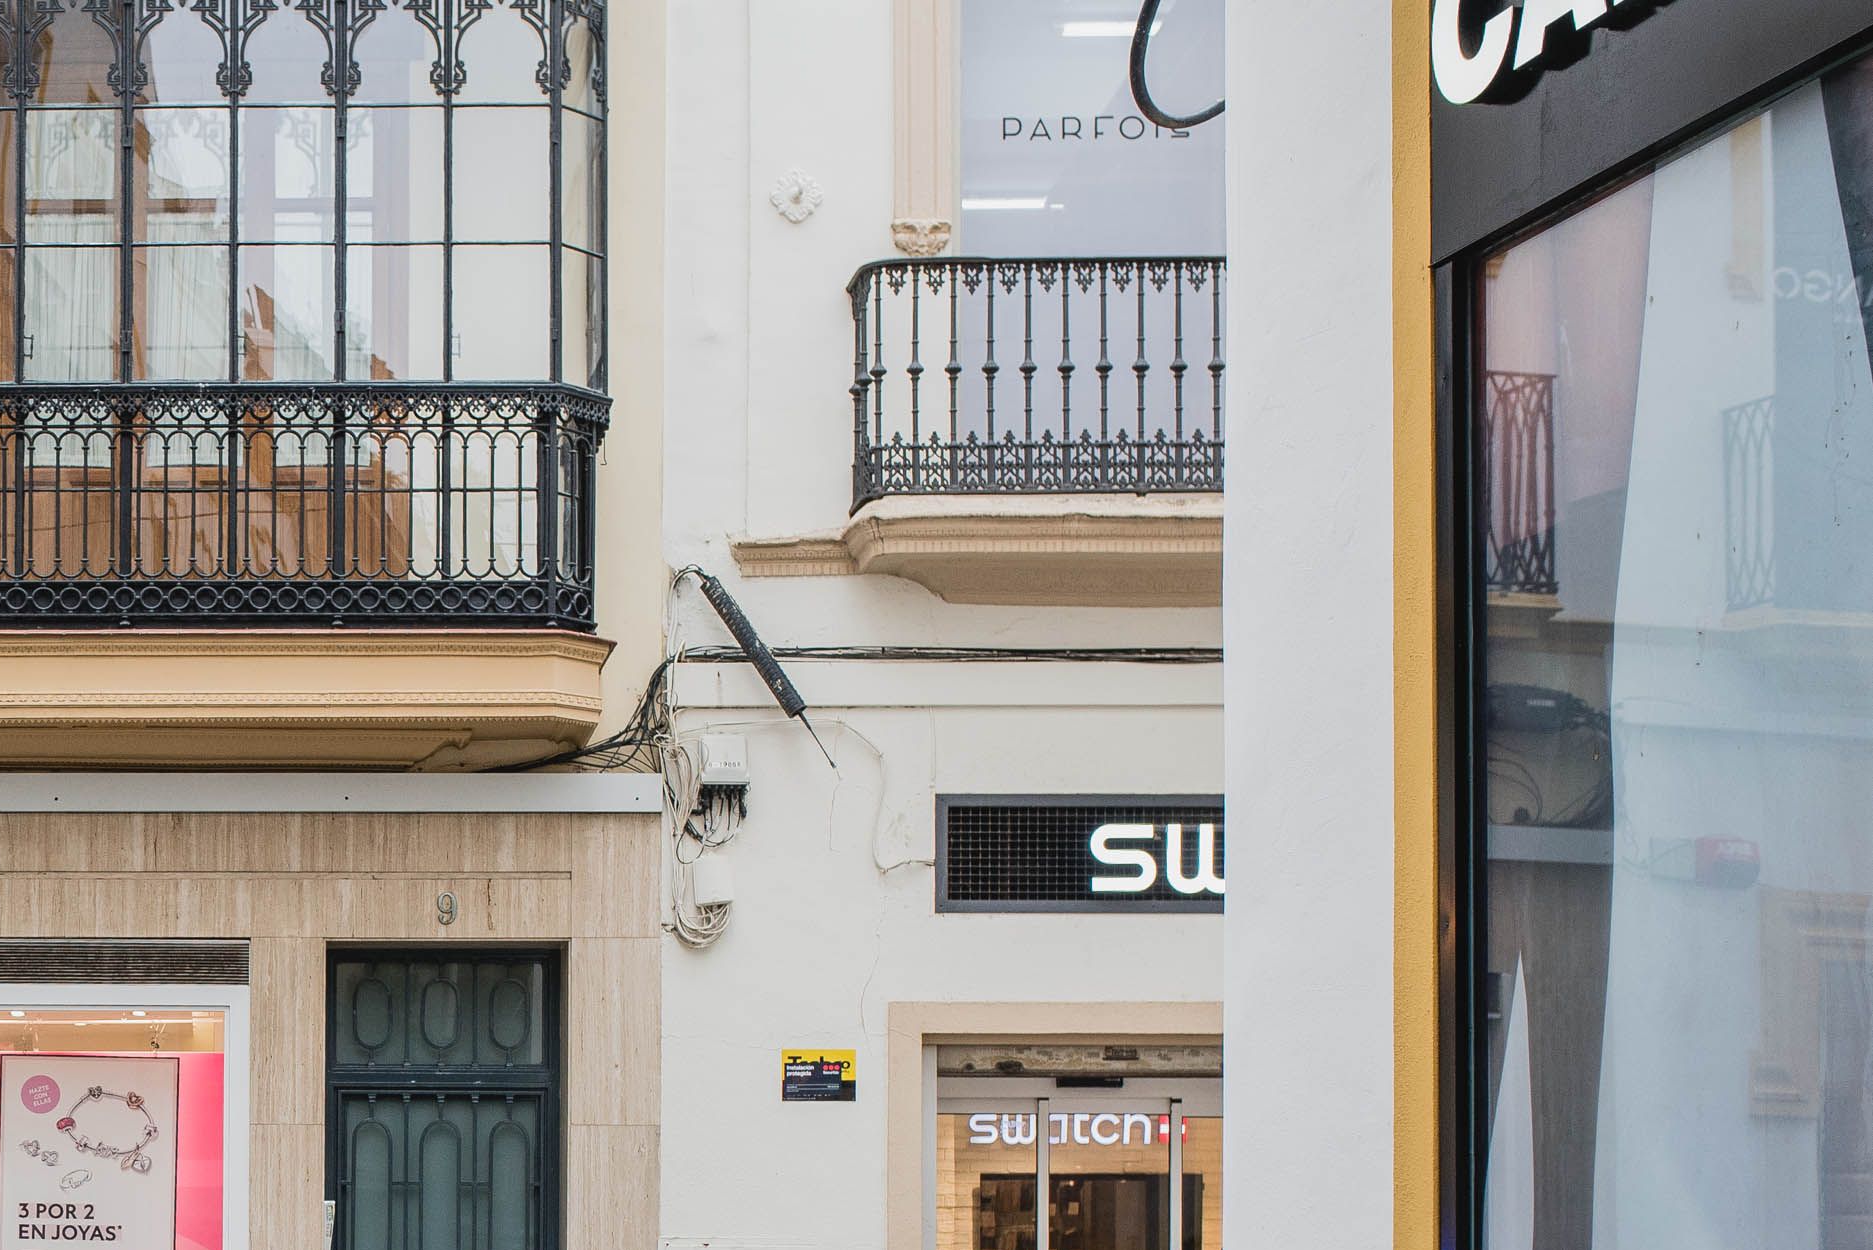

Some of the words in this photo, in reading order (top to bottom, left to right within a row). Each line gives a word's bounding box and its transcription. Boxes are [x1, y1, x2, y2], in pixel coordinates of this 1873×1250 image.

[437, 891, 458, 926] 9
[18, 1203, 29, 1219] 3
[36, 1203, 77, 1219] POR
[83, 1204, 95, 1219] 2
[18, 1224, 46, 1240] EN
